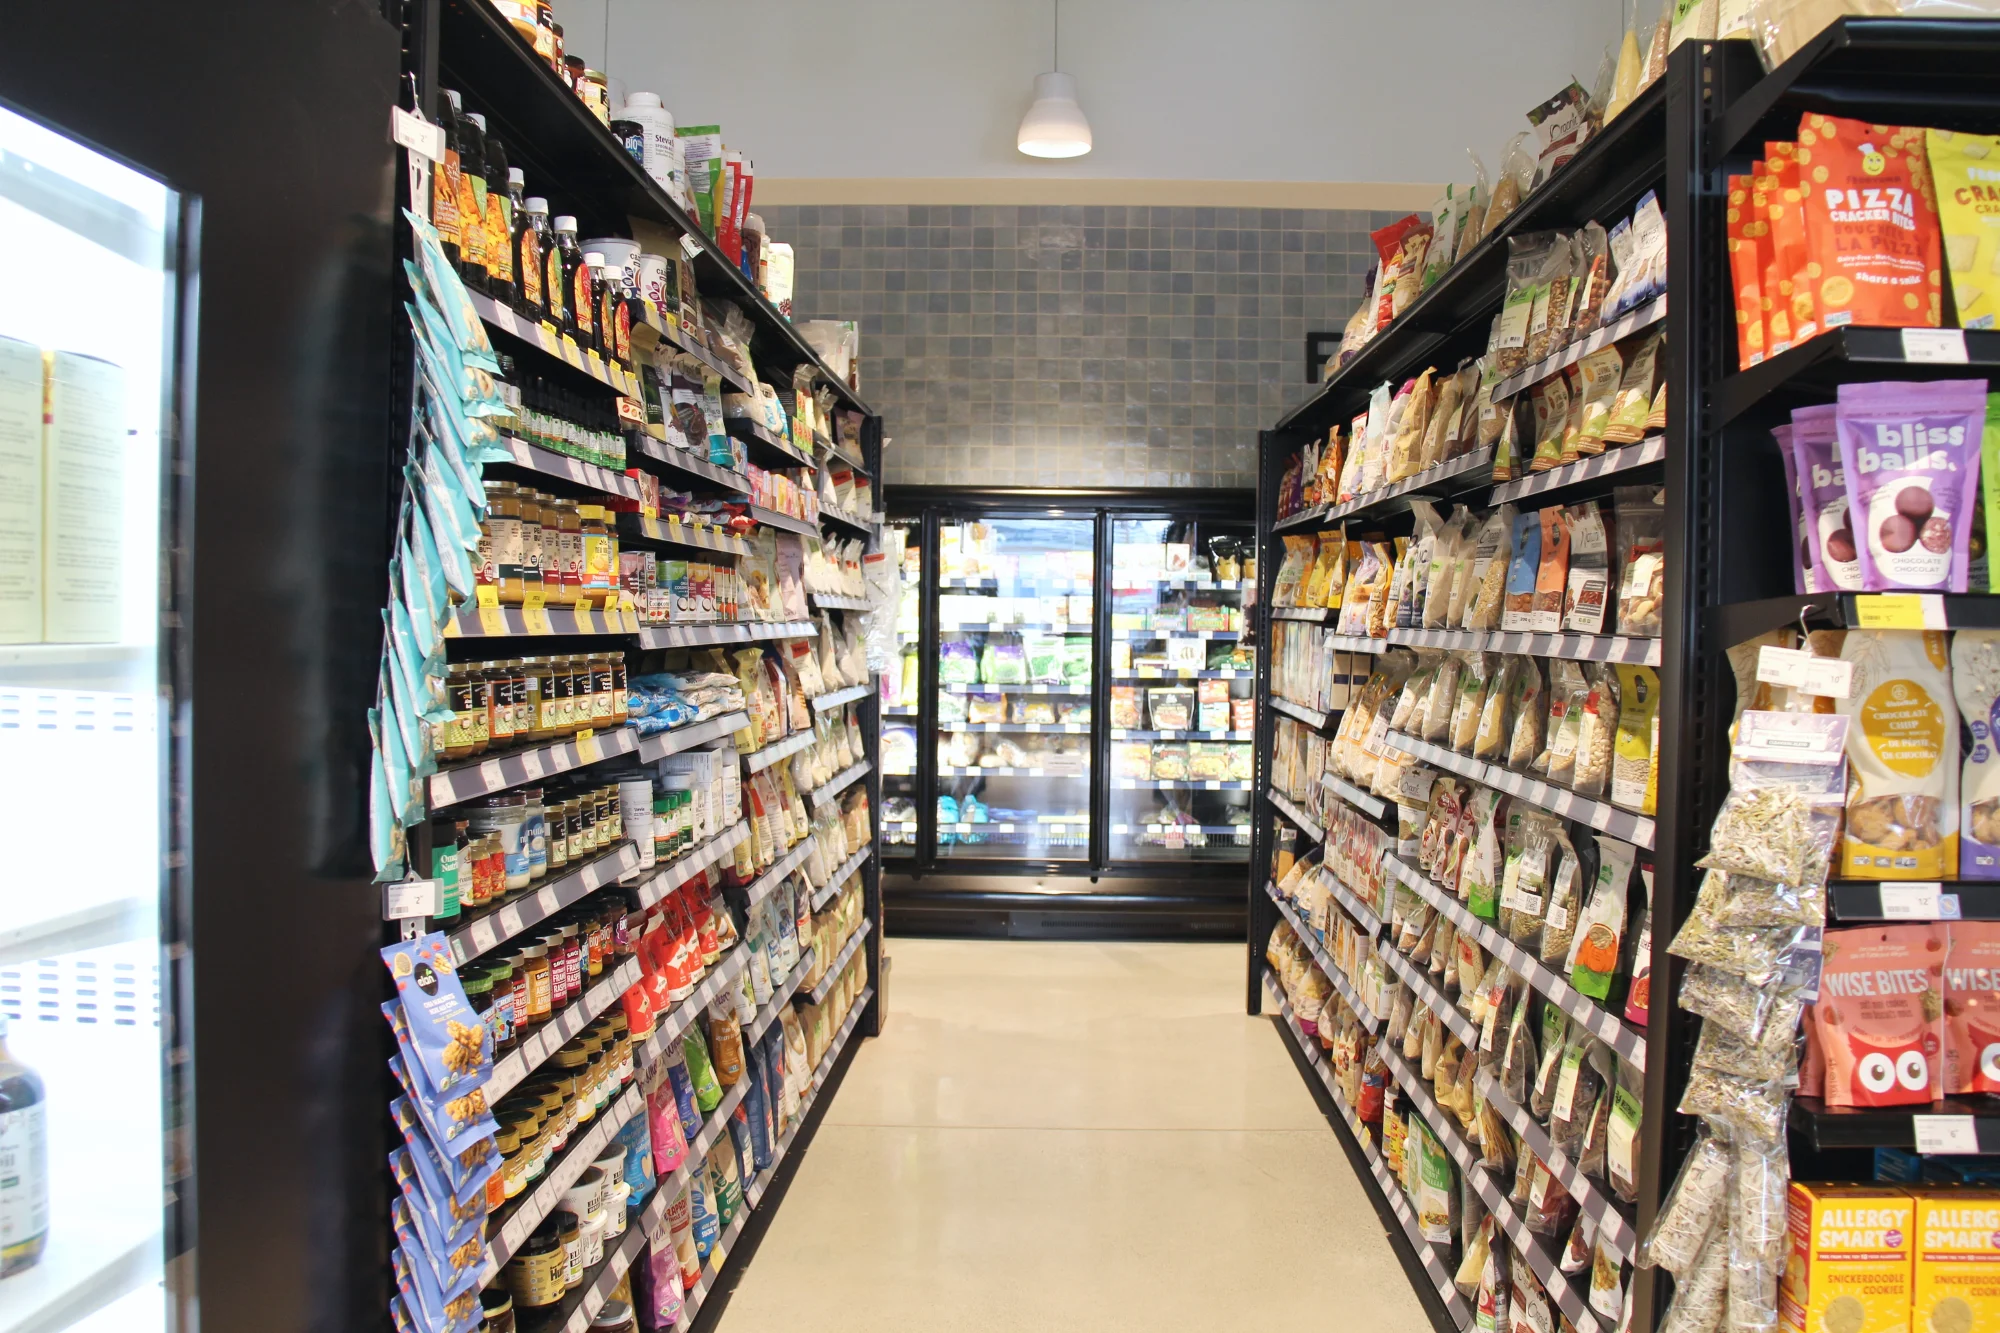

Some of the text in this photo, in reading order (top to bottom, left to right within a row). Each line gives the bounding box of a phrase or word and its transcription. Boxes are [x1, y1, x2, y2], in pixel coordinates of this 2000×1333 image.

[1825, 188, 1914, 217] PIZZA
[1954, 185, 2000, 206] CRA
[1830, 209, 1916, 231] CRACKER BITES
[1855, 271, 1888, 284] share
[1876, 423, 1965, 447] bliss
[1812, 464, 1845, 489] ba
[1892, 557, 1942, 565] CHOCOLATE
[1894, 565, 1940, 573] CHOCOLAT
[1873, 709, 1929, 720] CHOCOLATE
[1889, 720, 1919, 730] CHIP
[1825, 968, 1929, 997] WISE BITES
[1947, 968, 2000, 991] WISE
[1820, 1208, 1909, 1228] ALLERGY
[1925, 1209, 2000, 1228] ALLERG
[1818, 1229, 1887, 1249] SMART
[1923, 1230, 1993, 1249] SMART
[1828, 1273, 1905, 1284] SNICKERDOODLE
[1863, 1285, 1905, 1295] COOKIES
